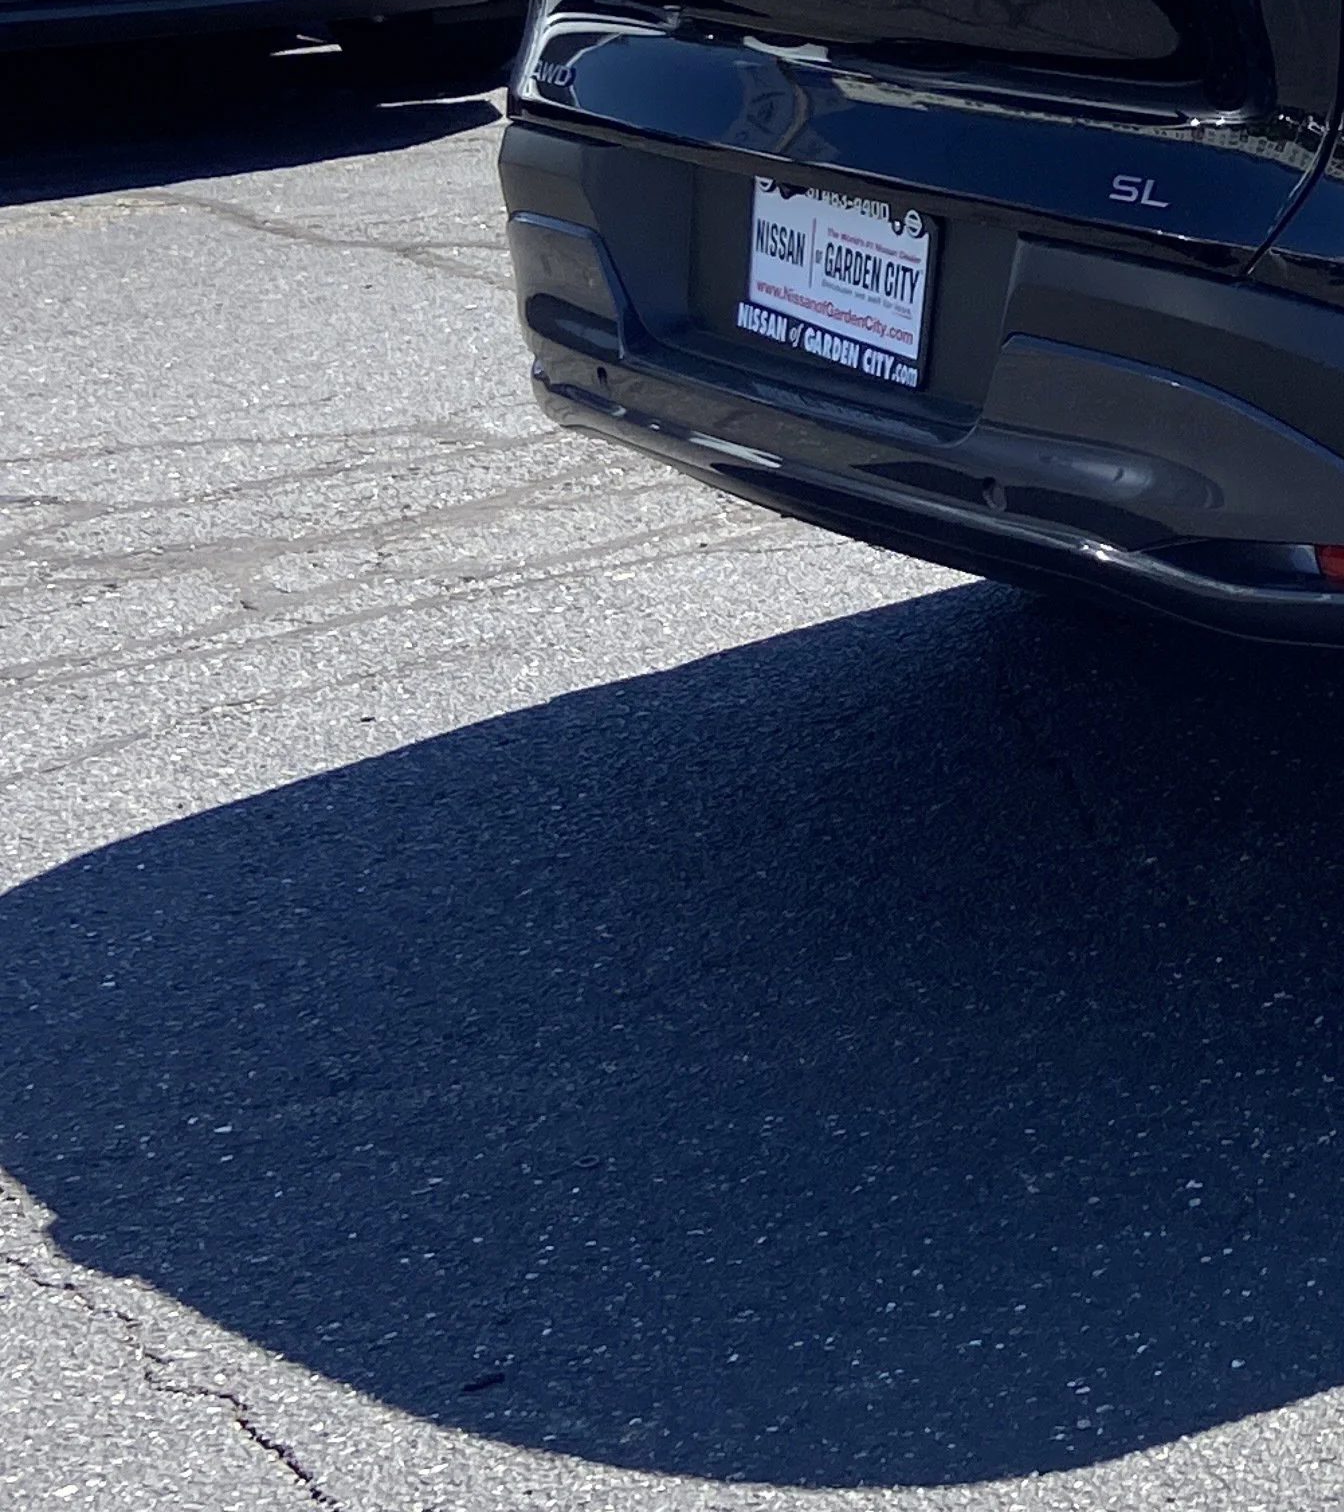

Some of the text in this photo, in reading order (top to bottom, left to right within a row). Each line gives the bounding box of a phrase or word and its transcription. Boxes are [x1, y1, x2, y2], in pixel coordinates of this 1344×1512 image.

[530, 60, 574, 87] AWD
[1109, 174, 1170, 208] SL
[756, 219, 806, 267] NISSAN
[824, 242, 882, 294] GARDEN
[883, 261, 920, 304] CITY
[737, 302, 919, 388] NISSAN of GARDEN CITY.com
[757, 279, 915, 346] www.NissanofGardenCity.com
